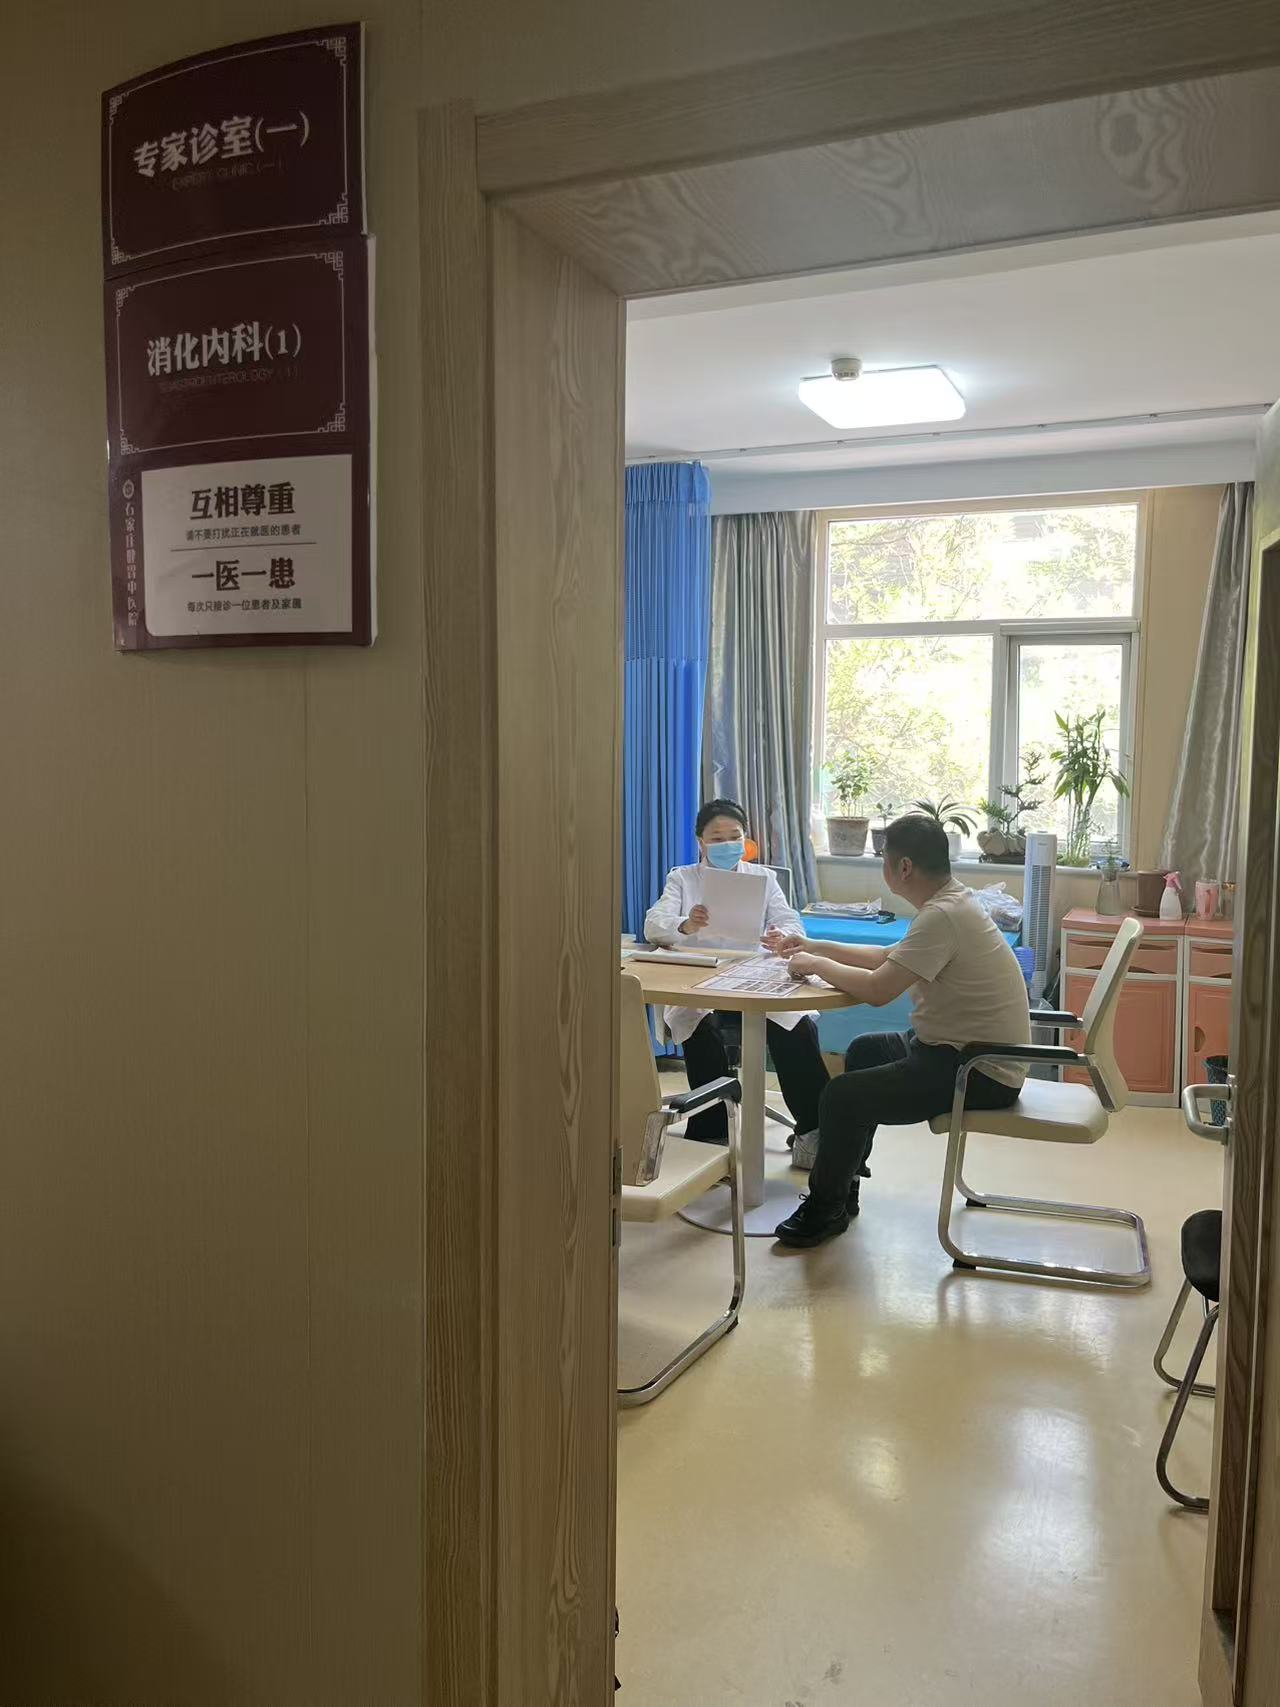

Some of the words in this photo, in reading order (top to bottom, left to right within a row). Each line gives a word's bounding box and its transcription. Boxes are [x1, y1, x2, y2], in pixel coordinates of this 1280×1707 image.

[133, 111, 311, 178] 专家诊室(一)
[147, 321, 302, 376] 消化内科(1)
[190, 481, 296, 520] 互相尊重
[186, 524, 301, 541] 请不要打扰正在就医的患者
[191, 557, 296, 591] 一医一患
[186, 598, 302, 613] 每次只接诊一位患者及家属
